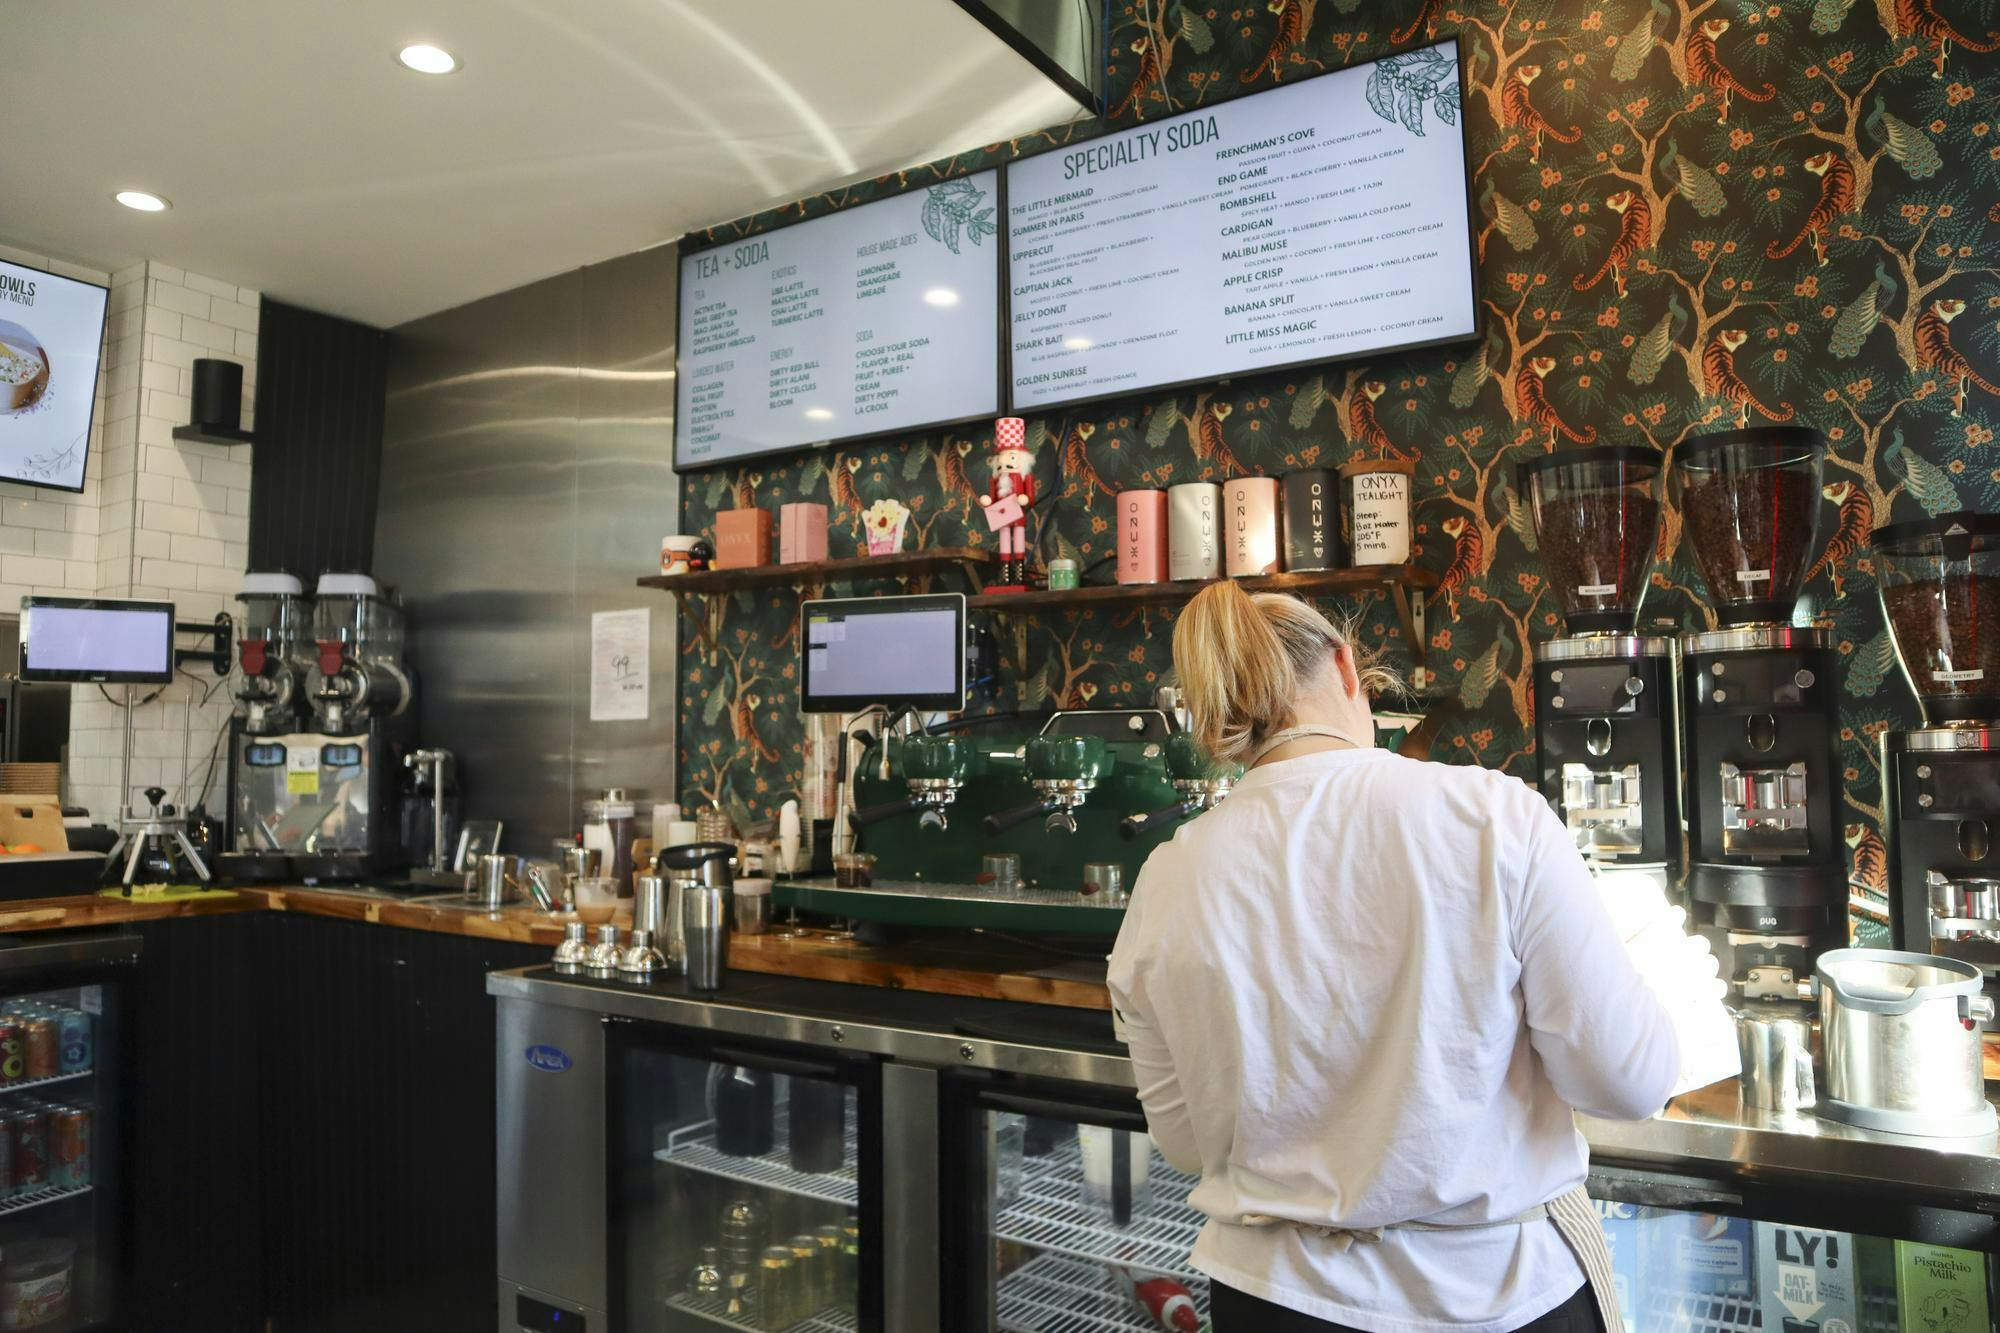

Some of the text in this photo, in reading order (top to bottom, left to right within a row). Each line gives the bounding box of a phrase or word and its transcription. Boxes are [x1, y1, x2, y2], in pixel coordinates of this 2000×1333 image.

[1064, 114, 1219, 180] SPECIALTY SODA
[1216, 127, 1315, 160] FRENCHMAN'S COVE
[1268, 151, 1285, 160] FRUIT
[1293, 144, 1315, 154] GUAVA
[1322, 134, 1354, 146] COCONUT
[1357, 127, 1381, 138] CREAM
[1291, 147, 1404, 179] BLACK CHERRY VANILLA CREAM
[1218, 166, 1267, 185] END GAME
[1012, 187, 1093, 215] THE LITTLE MERMAID
[1211, 189, 1233, 199] CREAM
[1220, 190, 1276, 211] BOMBSHELL
[1285, 197, 1309, 207] MANGO
[1317, 191, 1338, 200] FRESH
[1339, 186, 1355, 195] LIME
[1012, 212, 1084, 236] SUMMER IN PARIS
[1293, 219, 1331, 232] BLUEBERRY
[1339, 211, 1367, 222] VANILLA
[1369, 206, 1388, 215] COLD
[1390, 201, 1411, 211] FOAM
[1221, 217, 1272, 236] CARDIGAN
[1294, 246, 1326, 257] COCONUT
[1334, 240, 1355, 249] FRESH
[1358, 236, 1373, 244] LIME
[1381, 227, 1415, 239] COCONUT
[1418, 221, 1443, 231] CREAM
[1012, 244, 1053, 261] UPPERCUT
[1222, 239, 1287, 260] MALIBU MUSE
[695, 253, 719, 280] TEA
[734, 240, 768, 269] SODA
[856, 260, 895, 277] LEMONADE
[1290, 274, 1318, 284] VANILLA
[1325, 268, 1348, 277] FRESH
[1349, 263, 1373, 273] LEMON
[1380, 256, 1410, 266] VANILLA
[1412, 250, 1438, 260] CREAM
[784, 281, 803, 292] LATTE
[856, 270, 900, 288] ORANGEADE
[1014, 276, 1072, 295] CAPTIAN JACK
[1223, 267, 1283, 287] APPLE CRISP
[10, 292, 34, 307] MENU
[771, 287, 819, 306] MATCHA LATTE
[856, 285, 886, 299] LIMEADE
[1282, 304, 1322, 316] CHOCOLATE
[1330, 297, 1358, 307] VANILLA
[1361, 293, 1383, 302] SWEET
[1386, 287, 1411, 297] CREAM
[771, 302, 806, 316] CHAI LATTE
[1014, 304, 1066, 322] JELLY DONUT
[1224, 294, 1294, 315] BANANA SPLIT
[771, 308, 823, 327] TURMERIC LATTE
[1225, 320, 1316, 344] LITTLE MISS MAGIC
[1279, 337, 1315, 348] LEMONADE
[1323, 332, 1345, 341] FRESH
[1347, 327, 1371, 337] LEMON
[1380, 319, 1415, 331] COCONUT
[1417, 314, 1443, 324] CREAM
[855, 337, 929, 359] CHOOSE YOUR SODA
[1015, 335, 1062, 351] SHARK BAIT
[770, 360, 819, 376] DIRTY RED BULL
[861, 351, 913, 368] FLAVOR REAL
[770, 377, 787, 387] DIRTY
[855, 365, 903, 381] FRUIT PUREE
[1016, 366, 1087, 386] GOLDEN SUNRISE
[769, 388, 787, 398] DIRTY
[855, 380, 879, 392] CREAM
[855, 388, 897, 403] DIRTY POPPI
[769, 398, 793, 409] BLOOM
[855, 401, 888, 415] LA CROIX
[1361, 475, 1398, 489] ONYX
[1356, 491, 1404, 501] TEALIGHT
[1775, 1229, 1839, 1268] LY!
[1914, 1256, 1972, 1273] Pistachio
[1785, 1273, 1810, 1290] OAT-
[1930, 1268, 1957, 1281] Milk
[1783, 1286, 1814, 1305] MILK
